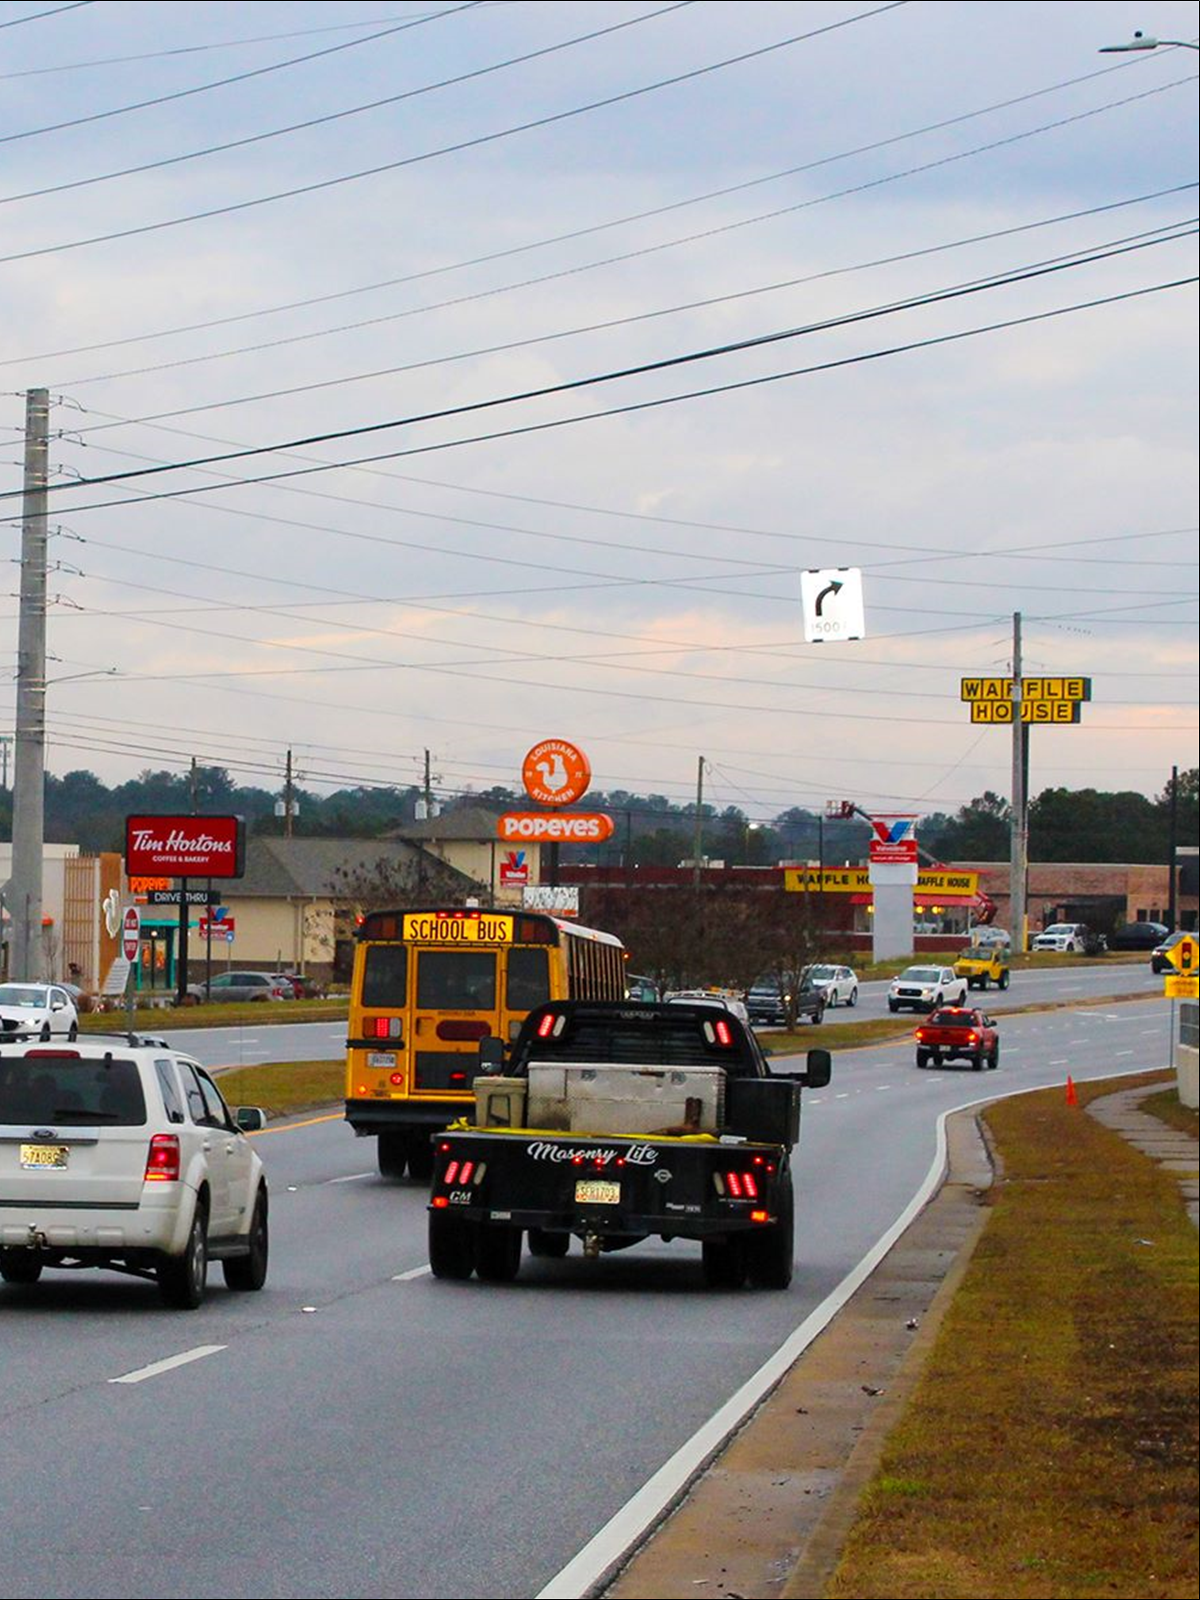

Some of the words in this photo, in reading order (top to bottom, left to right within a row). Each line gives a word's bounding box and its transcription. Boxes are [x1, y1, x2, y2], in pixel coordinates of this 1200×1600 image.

[965, 682, 1079, 697] WAFFLE
[976, 704, 1068, 718] HOUSE
[531, 742, 577, 761] LOUISIANA
[532, 788, 575, 802] KITCHEN
[132, 829, 164, 851] Tim
[165, 830, 232, 852] Hortons
[155, 893, 181, 903] DRIVE
[185, 893, 208, 903] THRU
[410, 919, 468, 940] SCHOOL
[478, 920, 506, 940] BUS
[527, 1142, 618, 1165] Masonry
[624, 1143, 659, 1165] Life
